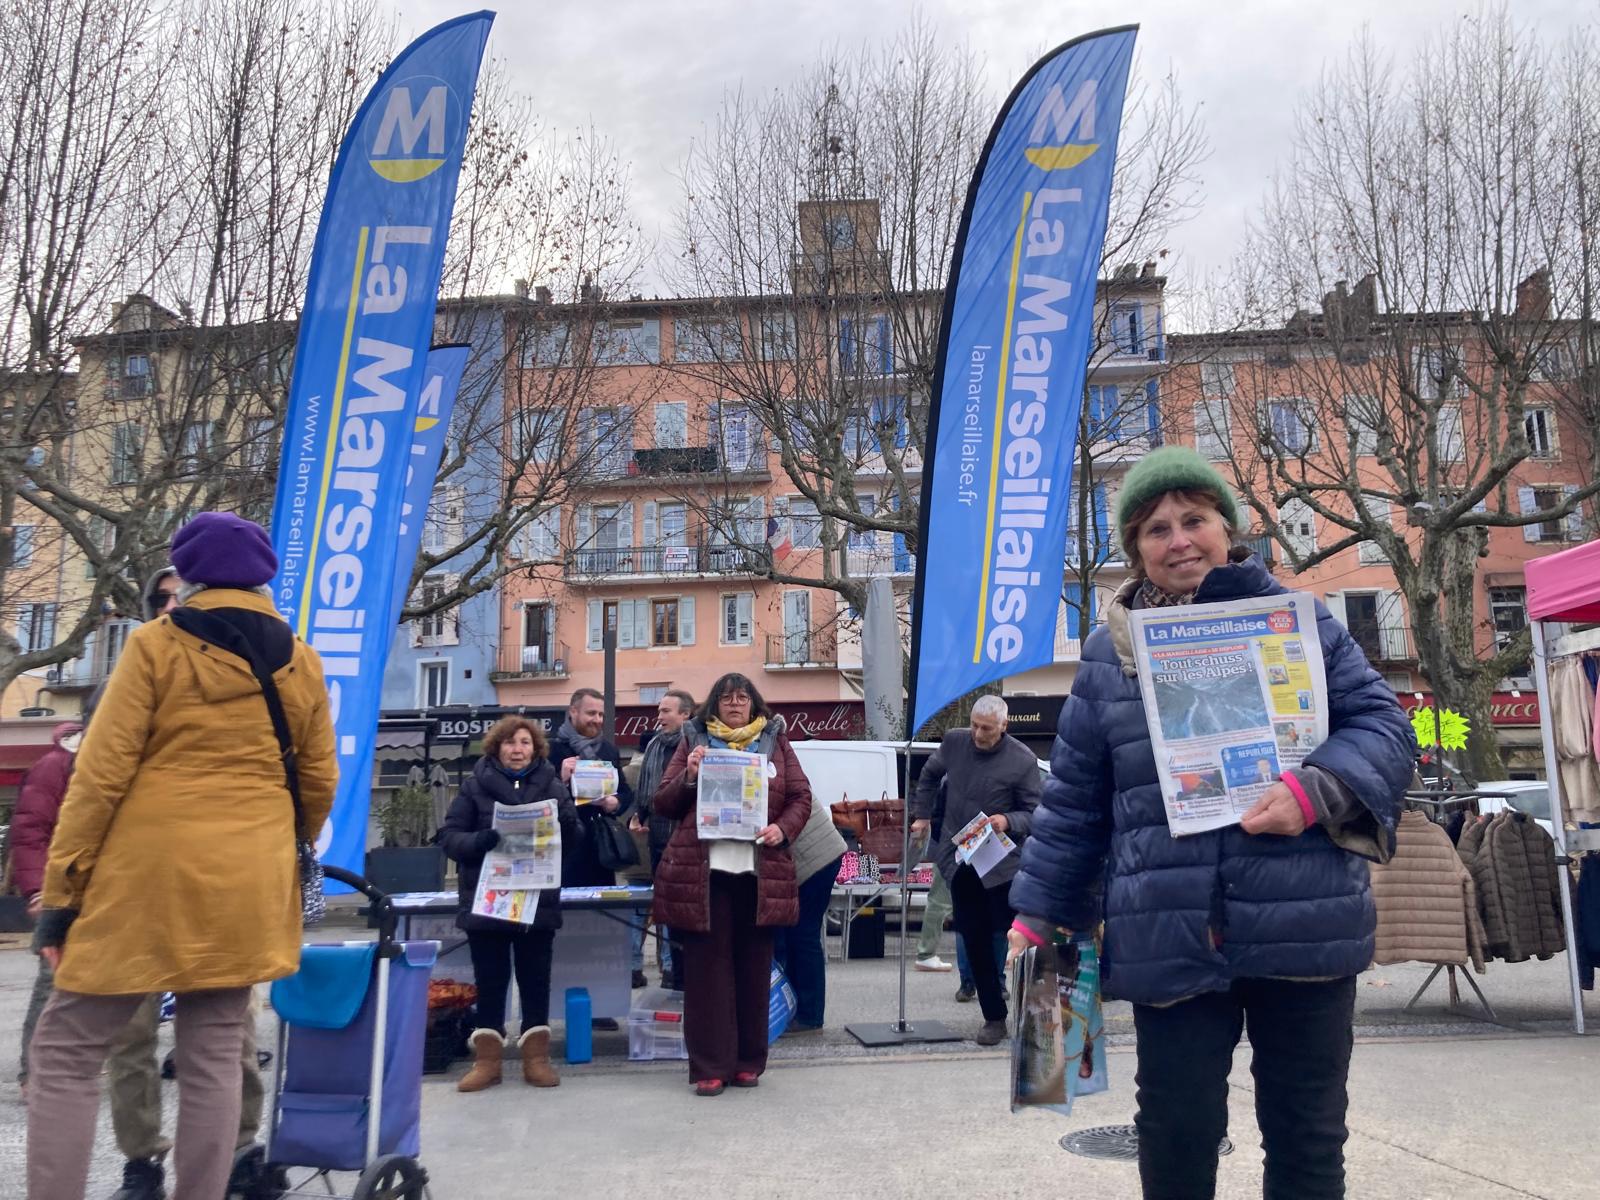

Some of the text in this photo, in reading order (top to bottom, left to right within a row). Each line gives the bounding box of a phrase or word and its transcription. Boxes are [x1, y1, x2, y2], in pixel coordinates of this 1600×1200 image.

[371, 86, 447, 155] M
[1028, 79, 1098, 143] M
[957, 345, 992, 507] lamarseillaise.fr
[986, 187, 1081, 663] La Marseillaise
[314, 225, 432, 868] La Marseill
[1150, 619, 1267, 641] La Marseillaise
[1160, 653, 1243, 671] Tout schuss
[1156, 671, 1178, 684] sur
[1183, 668, 1203, 682] les
[1204, 665, 1246, 681] Alpes
[789, 704, 851, 736] Ruelle
